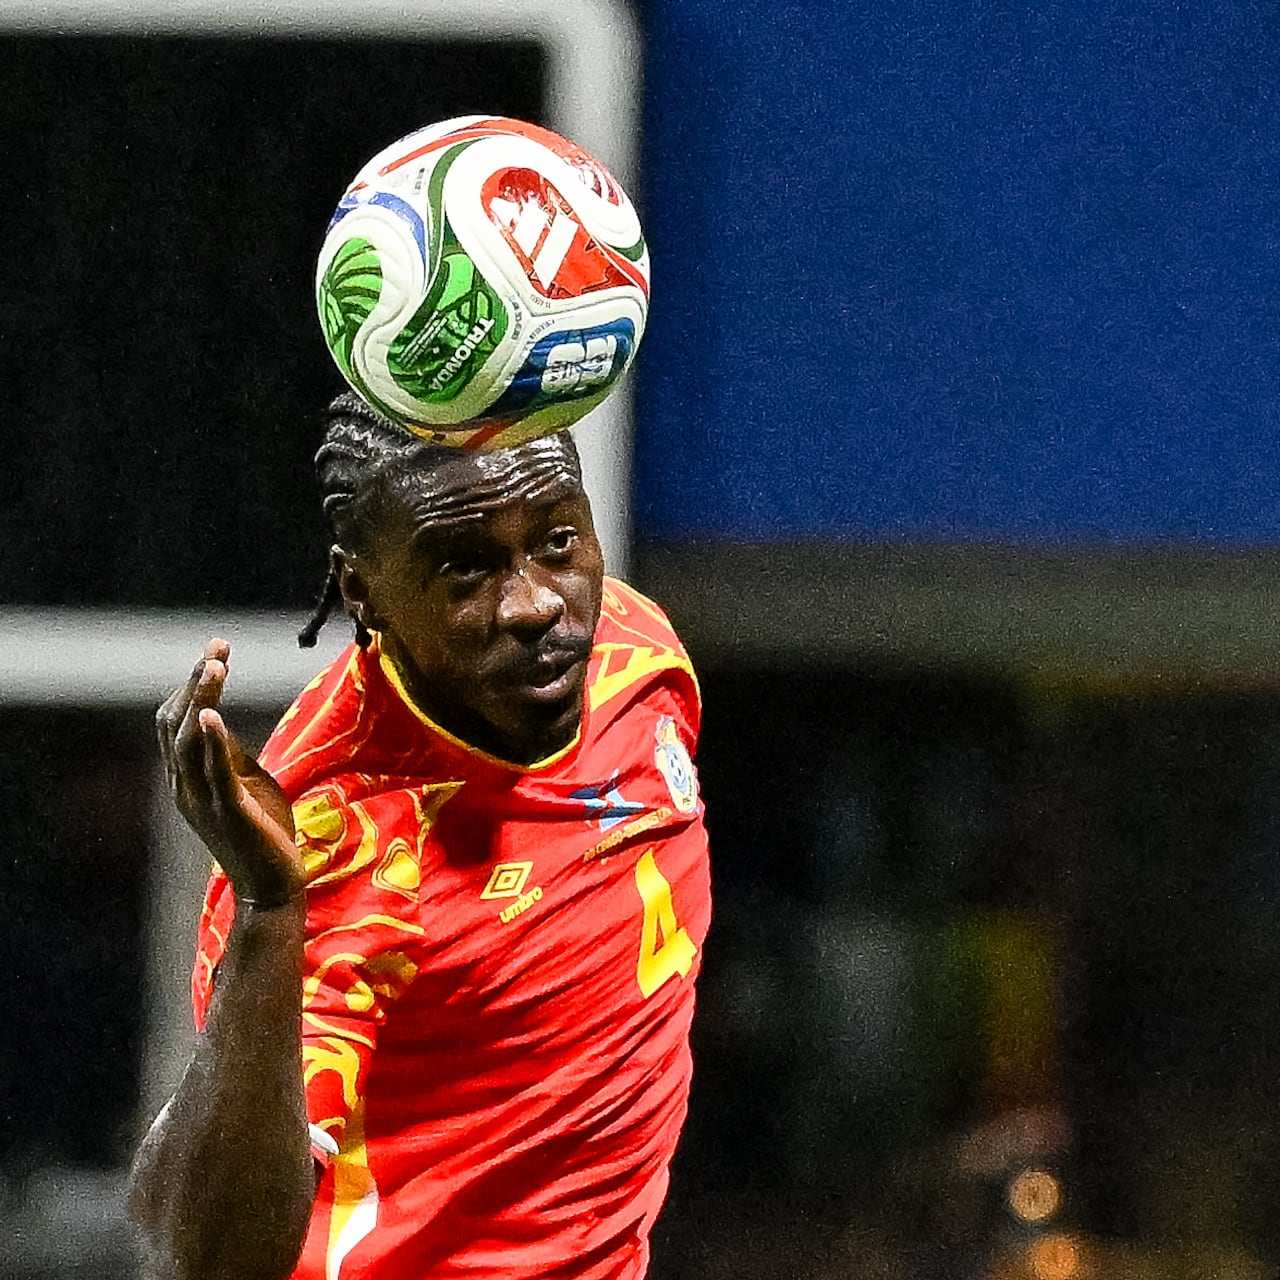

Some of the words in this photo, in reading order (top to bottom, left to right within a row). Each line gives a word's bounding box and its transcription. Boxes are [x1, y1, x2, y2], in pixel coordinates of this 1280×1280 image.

[428, 317, 495, 391] TRIONDA
[499, 886, 543, 923] umbro
[635, 848, 698, 999] 4
